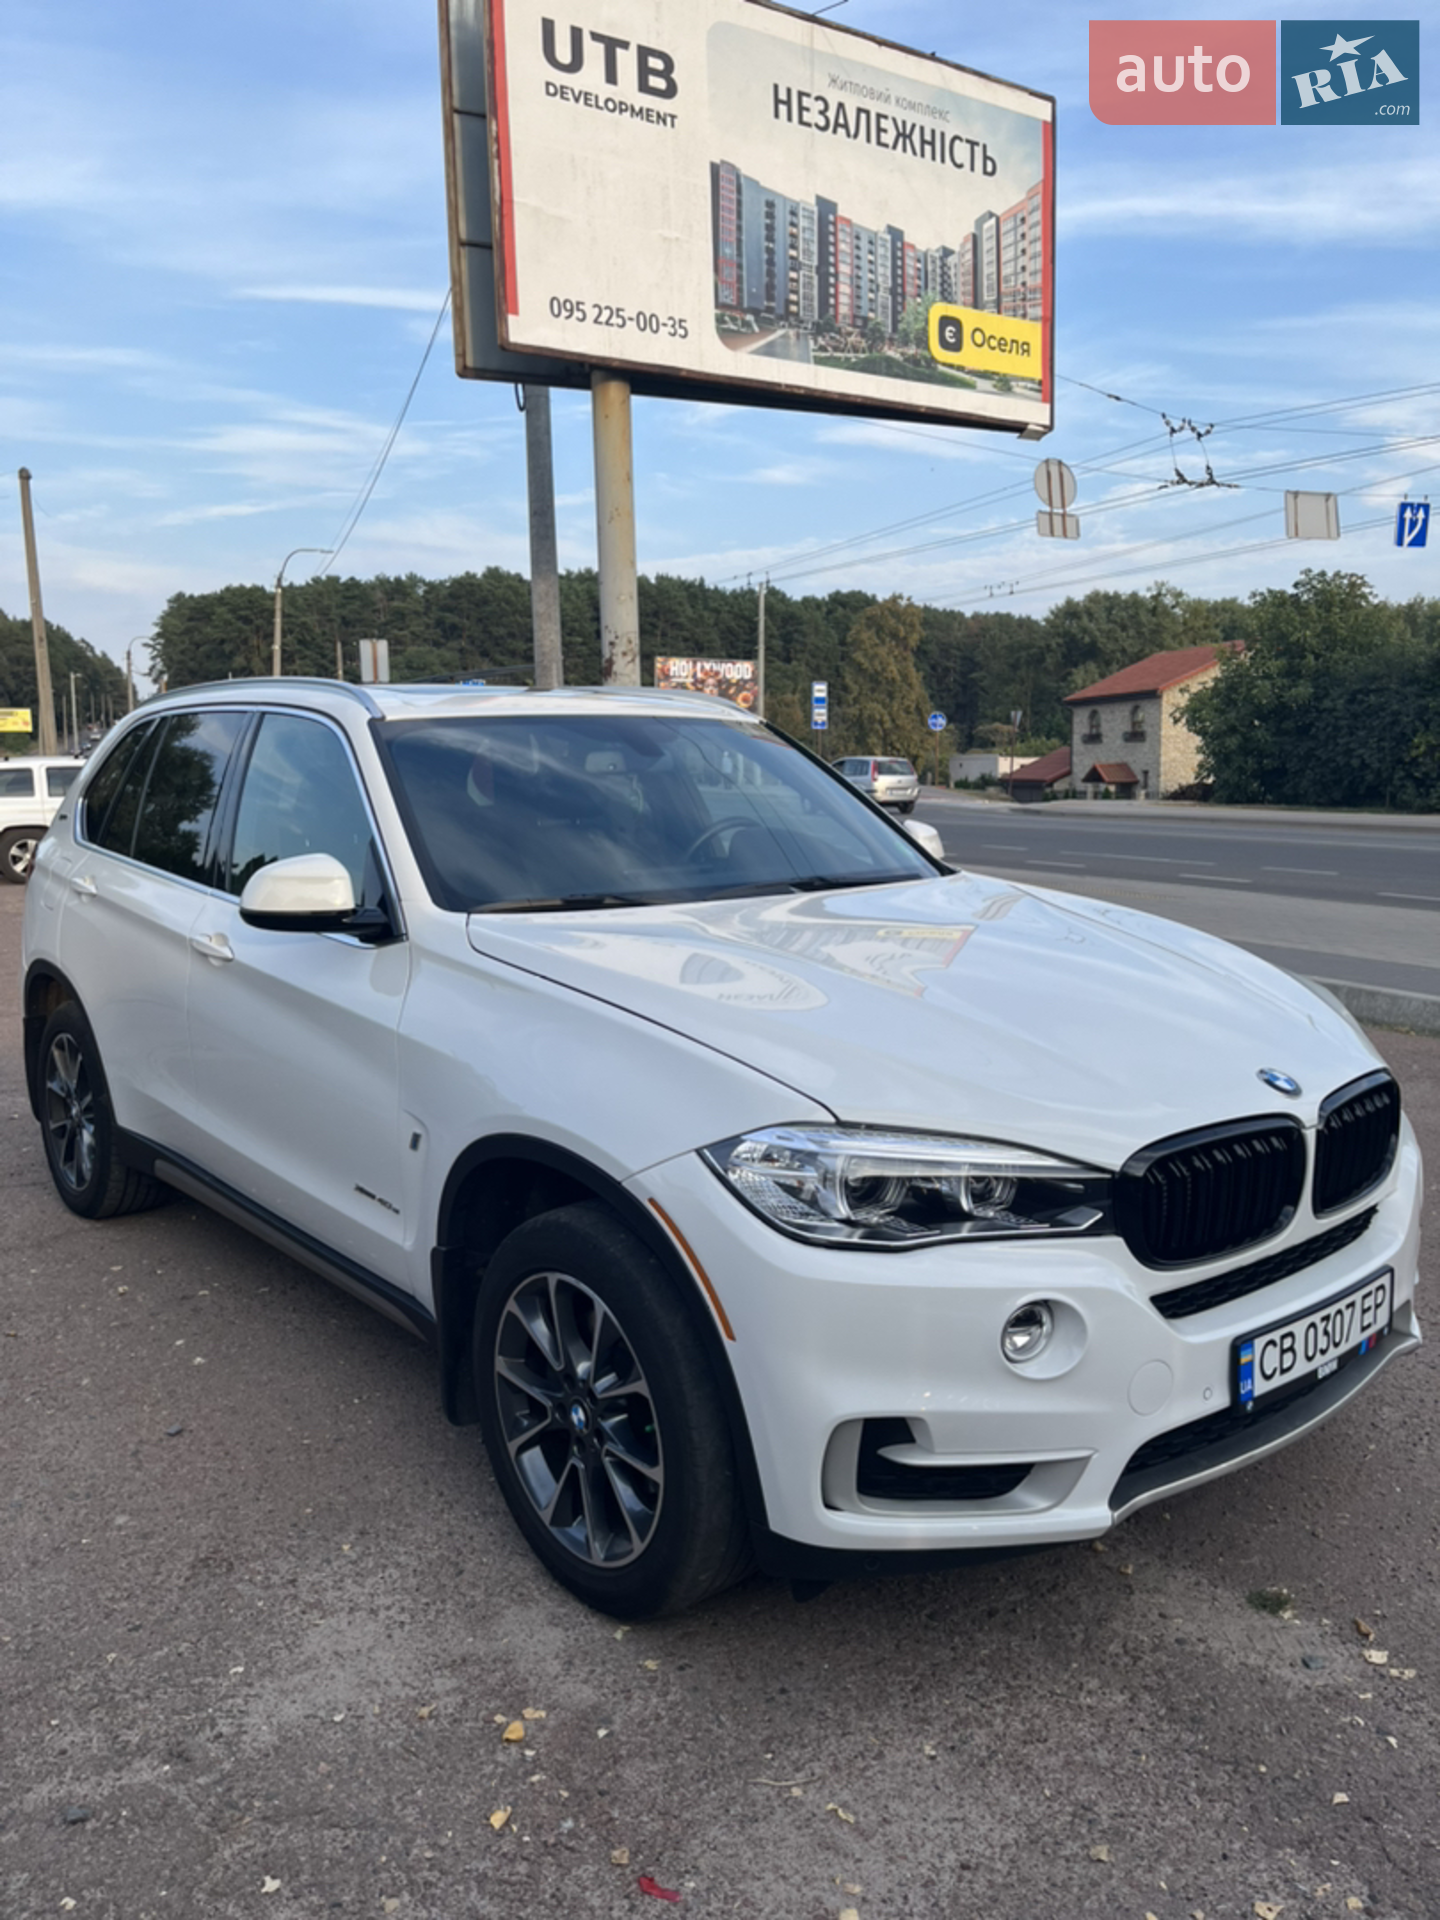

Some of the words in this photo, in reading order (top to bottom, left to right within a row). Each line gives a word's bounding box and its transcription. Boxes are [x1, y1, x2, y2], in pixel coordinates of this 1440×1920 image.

[541, 16, 678, 100] UTB
[545, 81, 678, 129] DEVELOPMENT
[827, 72, 892, 107] Житловий
[894, 93, 951, 123] комплекс
[772, 82, 998, 178] НЕЗАЛЕЖНІСТЬ
[549, 296, 587, 323] 095
[592, 303, 689, 339] 225-00-35
[970, 327, 1031, 358] Оселя
[1259, 1331, 1297, 1381] CB
[1304, 1300, 1356, 1363] 0307
[1360, 1283, 1387, 1334] EP
